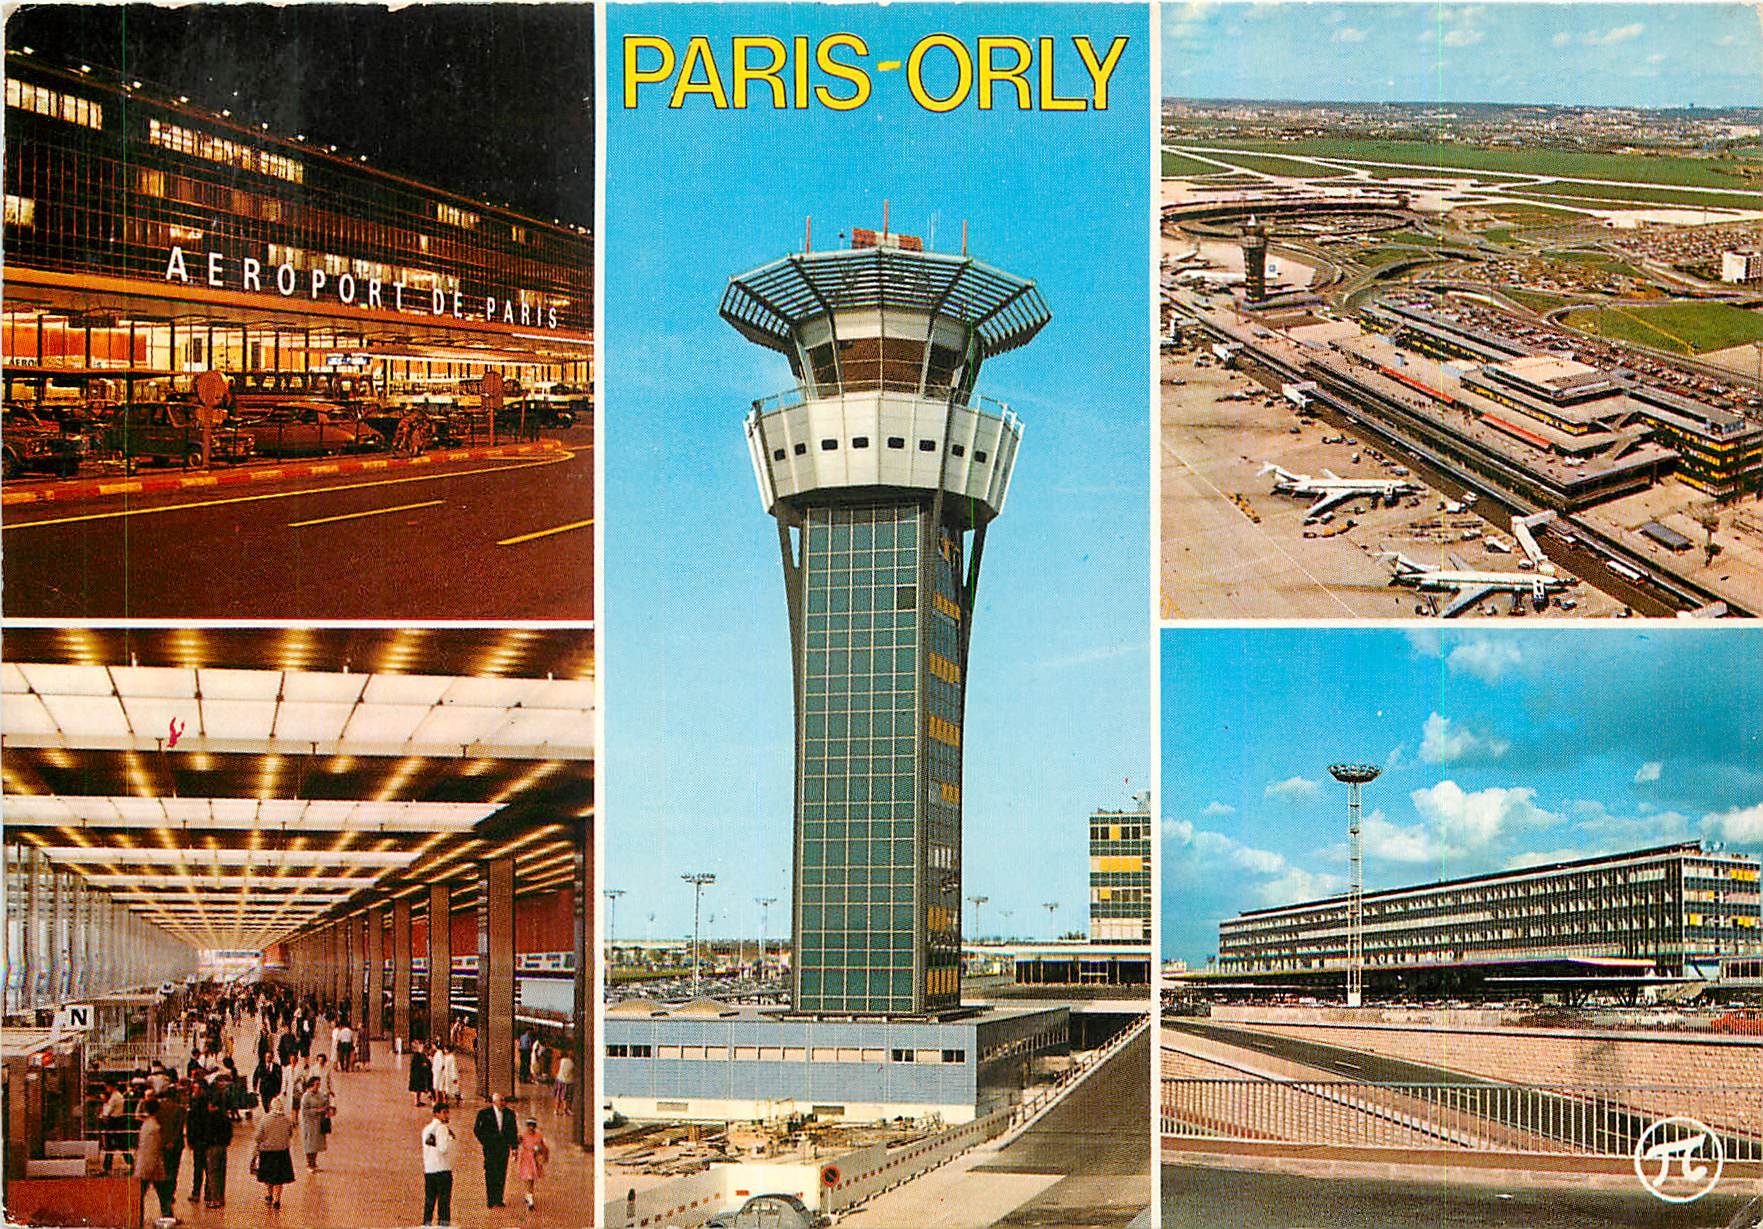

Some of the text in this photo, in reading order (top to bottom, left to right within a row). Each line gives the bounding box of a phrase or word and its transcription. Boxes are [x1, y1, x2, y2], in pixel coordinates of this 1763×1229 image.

[165, 245, 558, 330] AEROPORT DE PARIS
[70, 1008, 88, 1026] N
